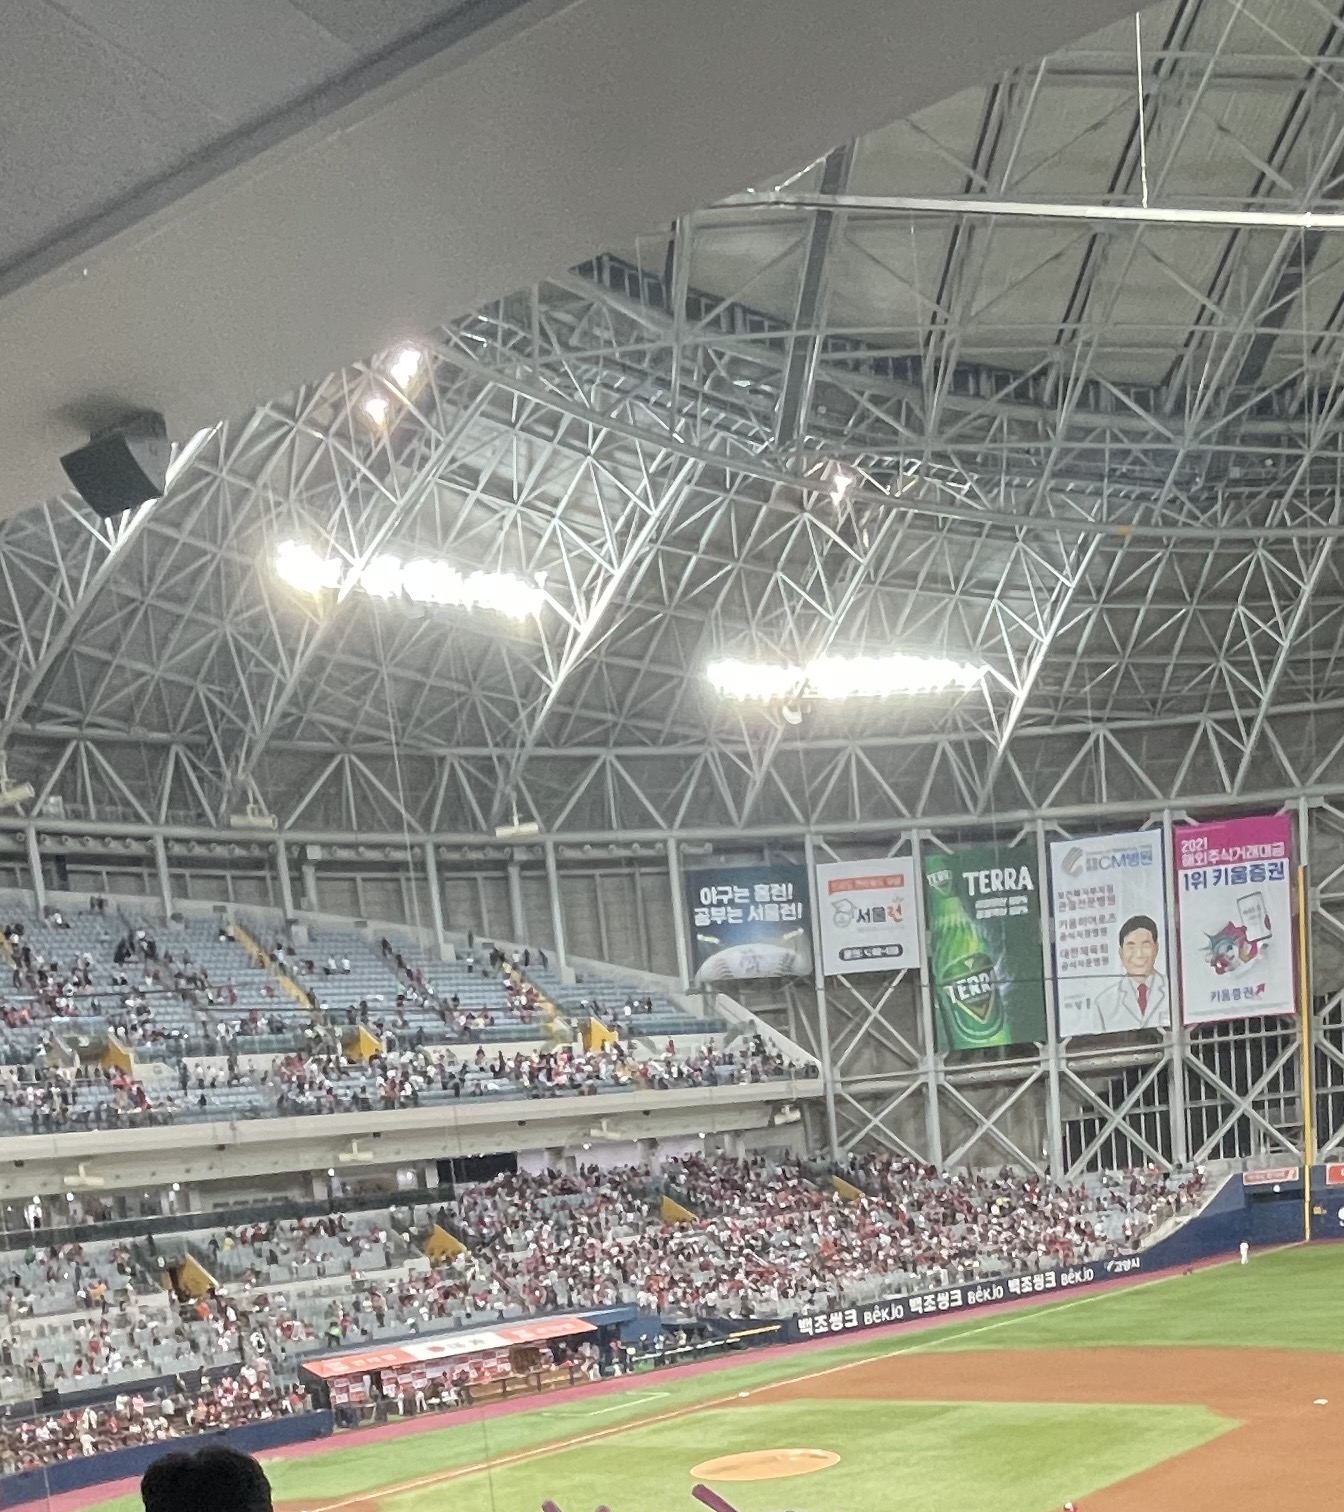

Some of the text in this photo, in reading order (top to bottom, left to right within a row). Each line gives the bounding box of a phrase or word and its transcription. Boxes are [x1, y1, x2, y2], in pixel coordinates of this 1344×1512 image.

[1181, 837, 1207, 854] 2021
[962, 865, 1035, 897] TERRA
[1184, 861, 1285, 891] 1위 키움증권
[699, 885, 749, 906] 야구는
[694, 906, 743, 926] 공부는
[798, 1309, 858, 1336] 백조씽크
[909, 1290, 963, 1315] 백조씽크
[1007, 1271, 1056, 1295] 백조씽크
